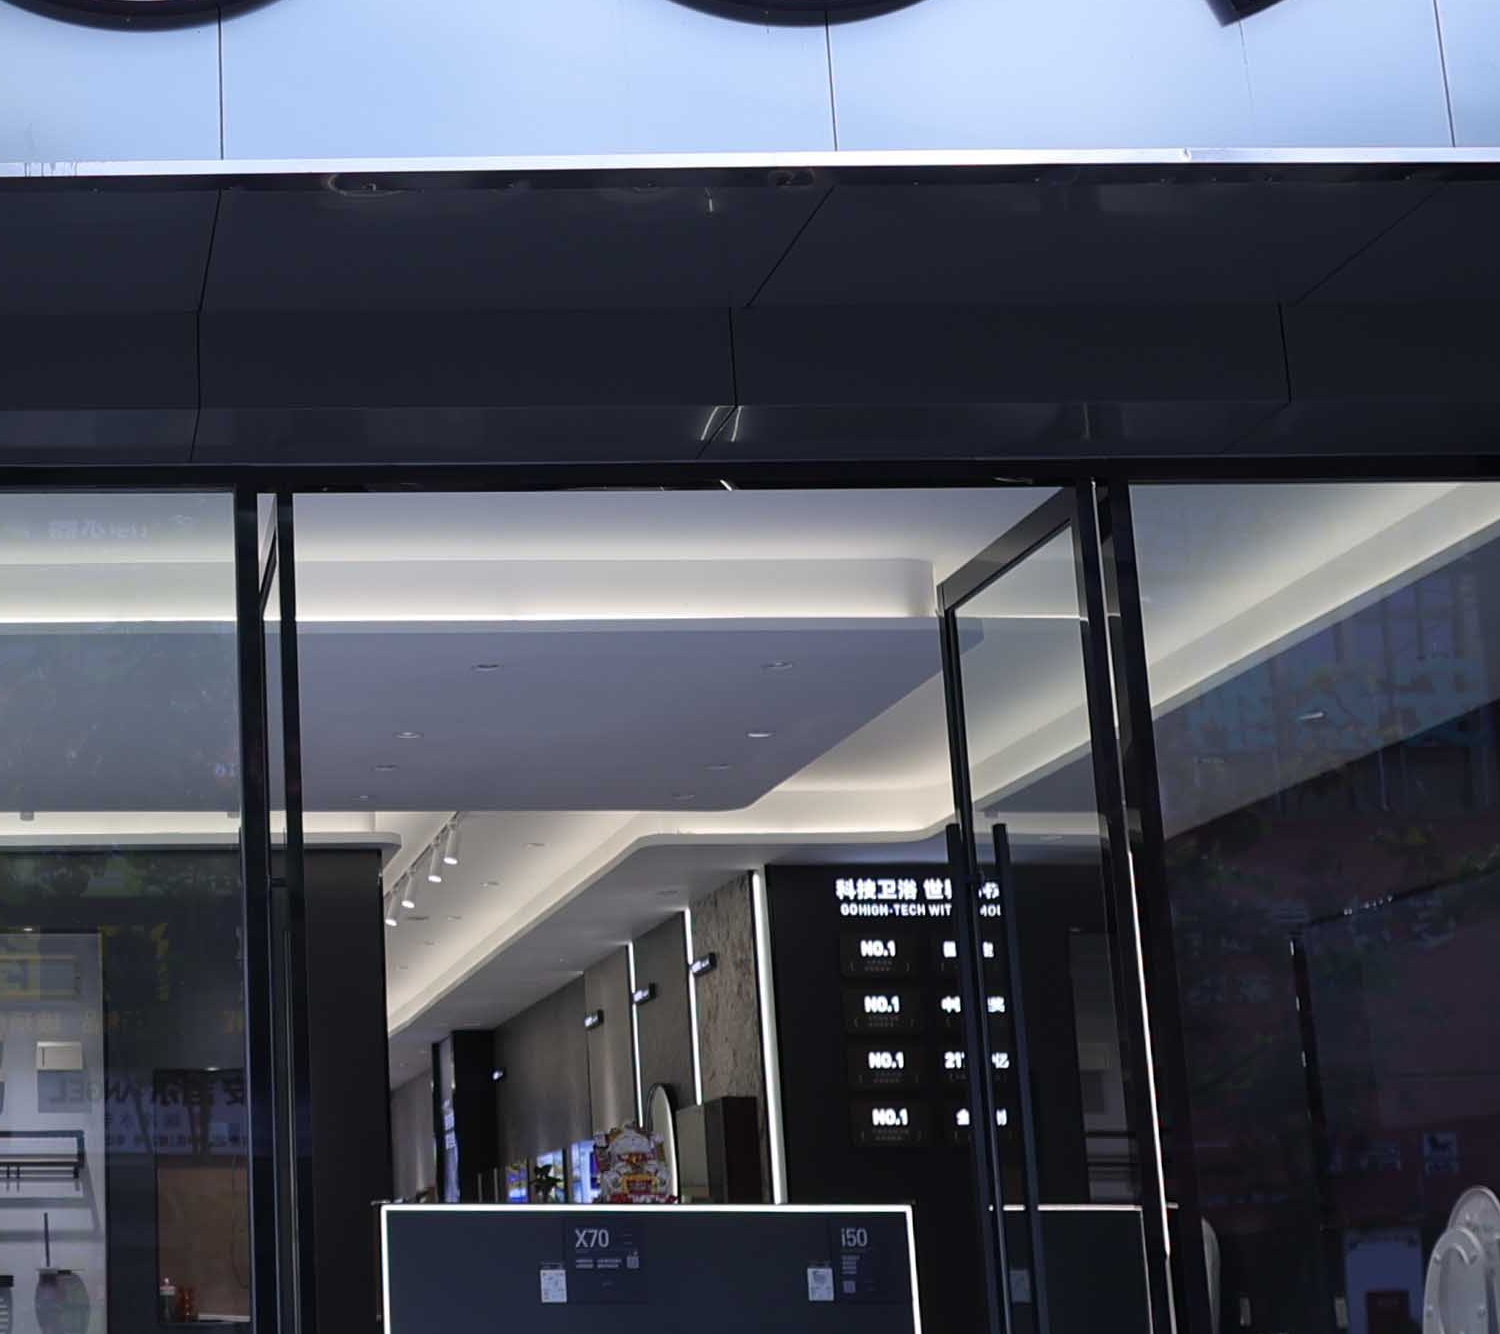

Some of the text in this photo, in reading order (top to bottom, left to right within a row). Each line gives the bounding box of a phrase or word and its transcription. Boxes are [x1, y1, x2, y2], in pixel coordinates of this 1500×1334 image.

[860, 939, 897, 957] NO.1
[863, 995, 900, 1013] NO.1
[868, 1051, 905, 1069] NO.1
[871, 1108, 909, 1126] NO.1
[574, 1228, 610, 1249] X70
[840, 1227, 869, 1248] i50
